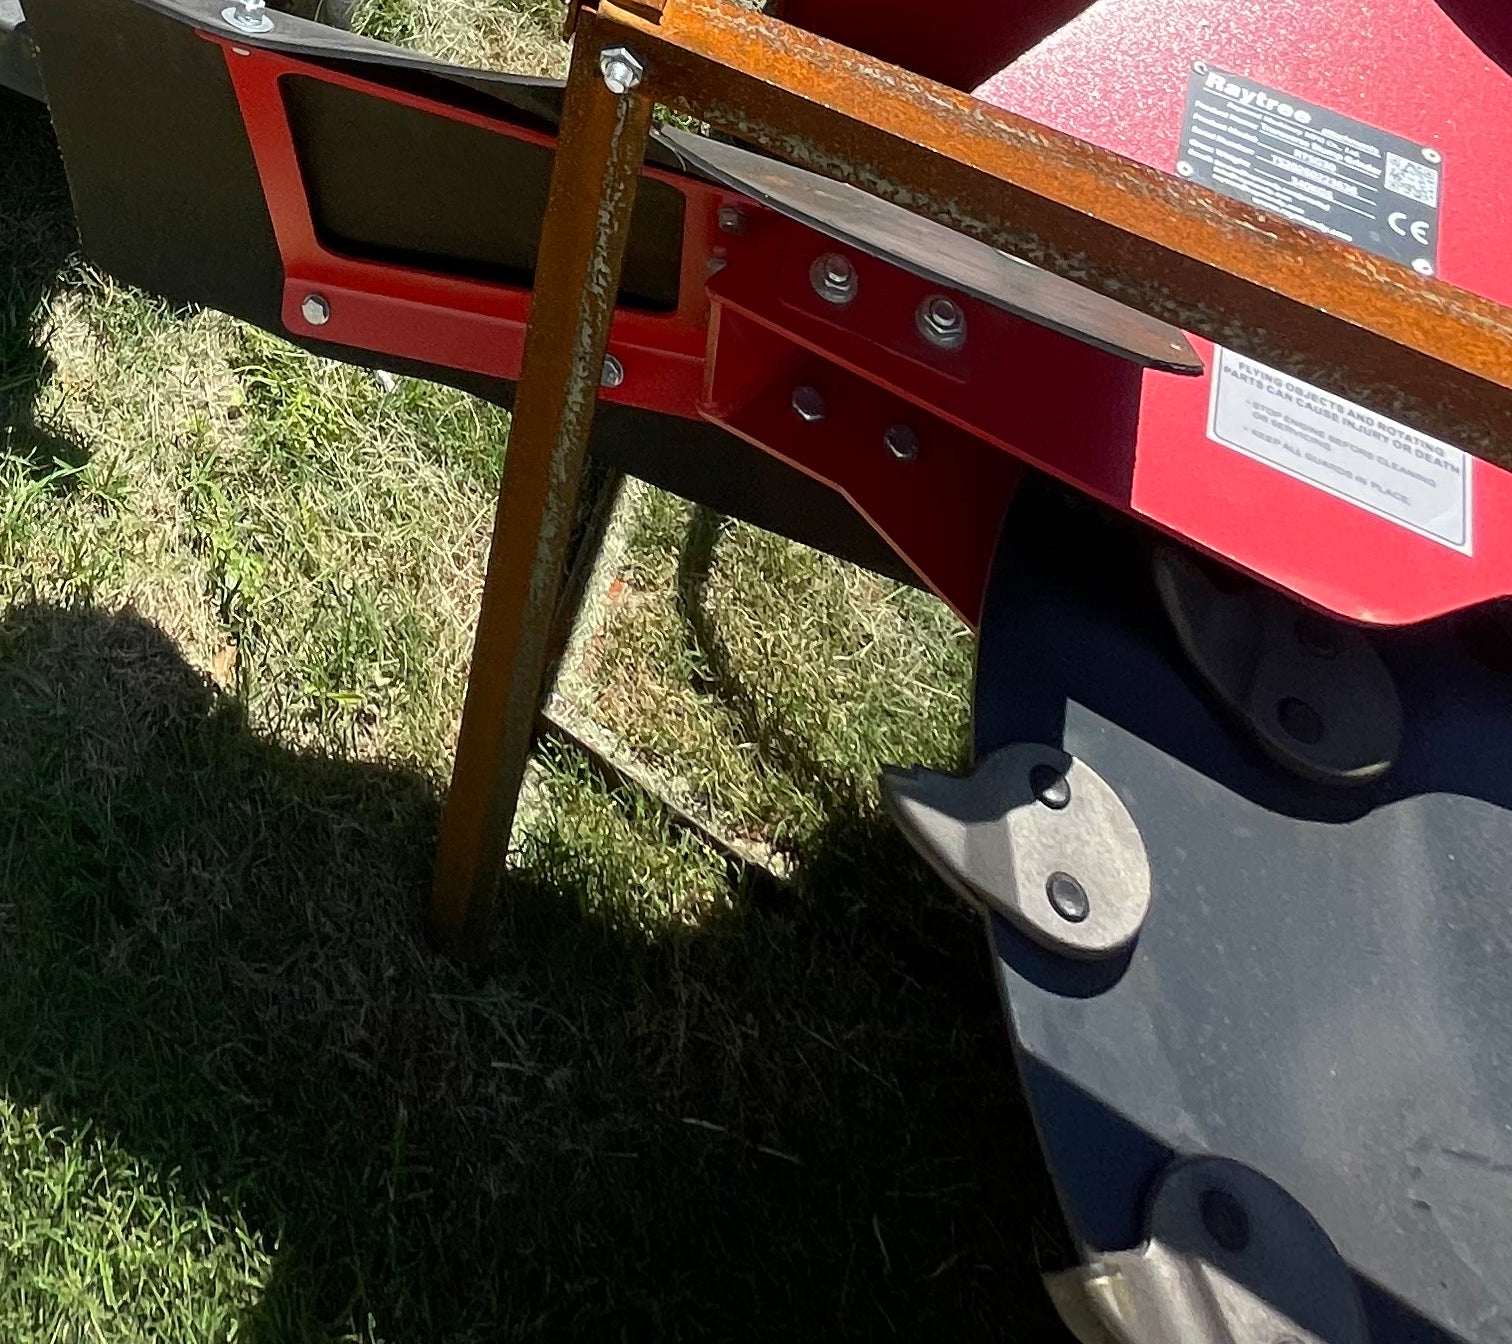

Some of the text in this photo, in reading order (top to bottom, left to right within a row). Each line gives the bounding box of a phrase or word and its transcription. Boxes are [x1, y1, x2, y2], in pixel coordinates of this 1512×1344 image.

[1205, 72, 1311, 124] Raytree
[1388, 212, 1430, 246] CE
[1223, 364, 1459, 475] PARTS CAN CAUSE INJURY OR DEATH
[1238, 360, 1444, 457] FLYING OBJECTS AND ROTATING
